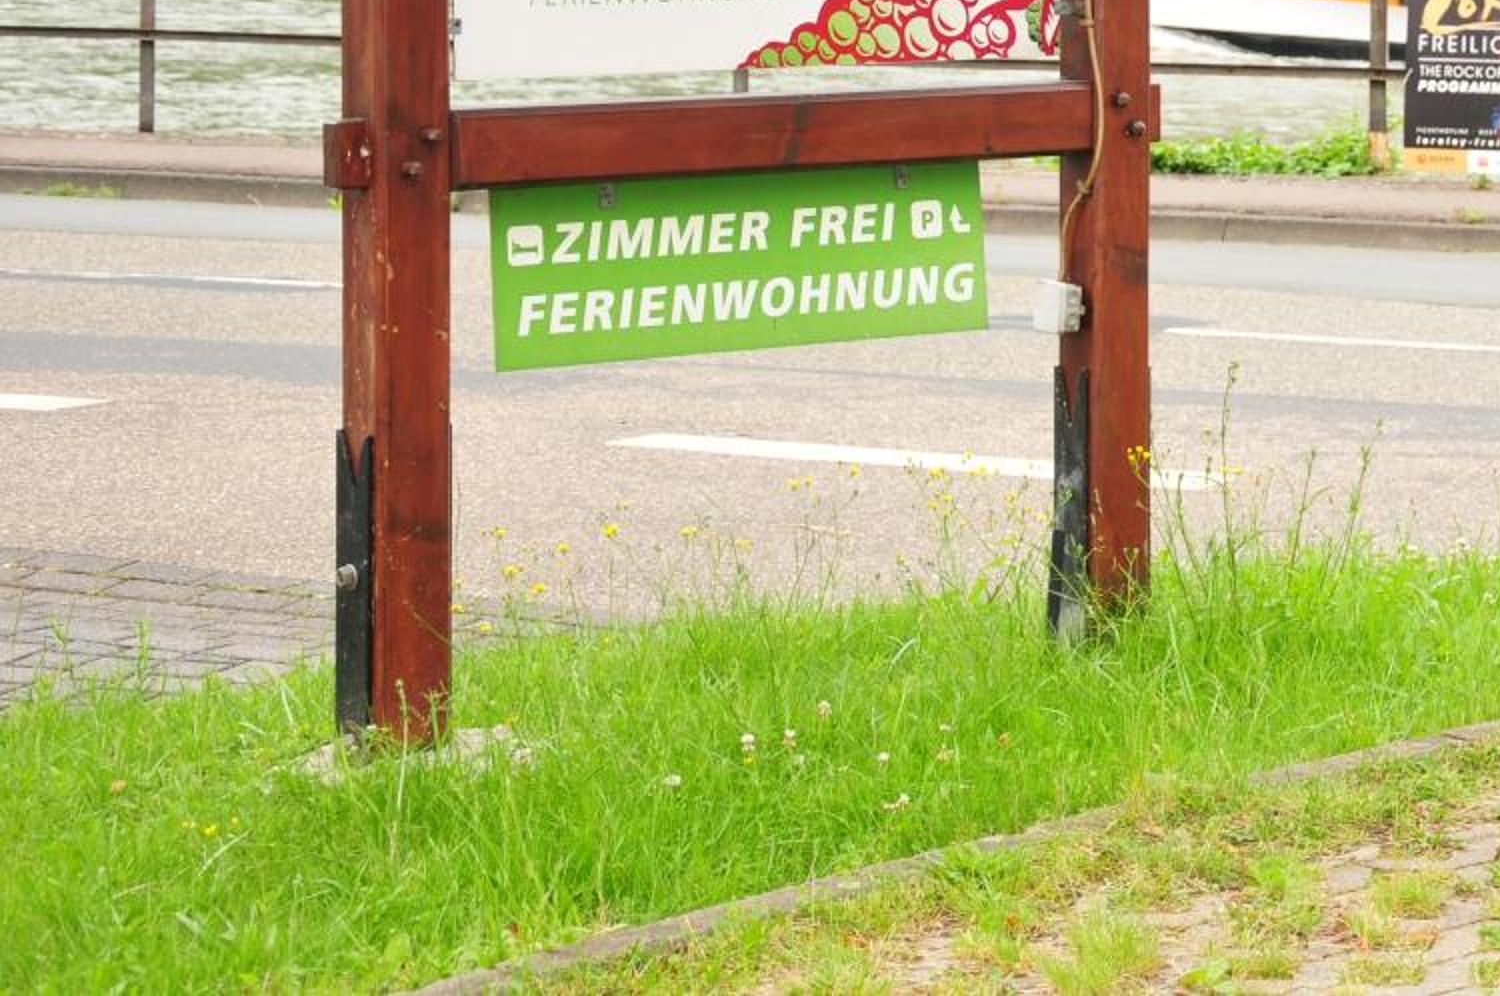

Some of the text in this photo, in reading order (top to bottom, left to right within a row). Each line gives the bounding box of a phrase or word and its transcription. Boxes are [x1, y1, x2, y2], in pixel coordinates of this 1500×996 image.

[1419, 64, 1443, 79] THE
[1444, 65, 1483, 80] ROCK
[551, 210, 770, 265] ZIMMER
[790, 202, 896, 250] FREI
[517, 262, 976, 338] FERIENWOHNUNG
